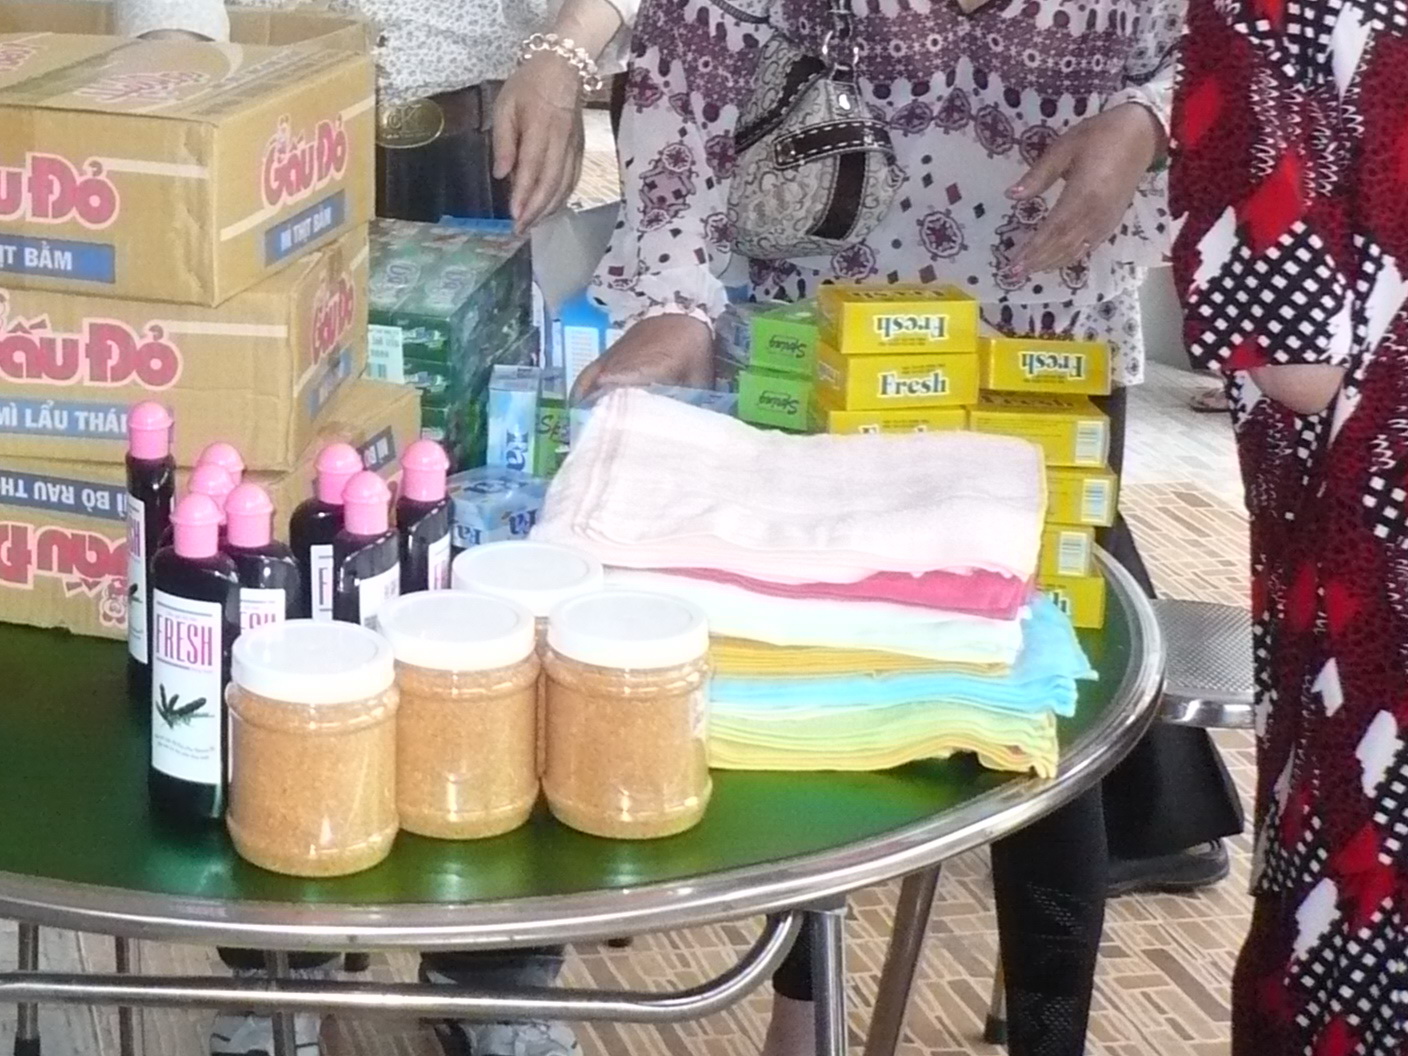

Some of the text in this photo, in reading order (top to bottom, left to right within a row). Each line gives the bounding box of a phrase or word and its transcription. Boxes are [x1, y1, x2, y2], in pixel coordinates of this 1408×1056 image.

[24, 241, 73, 271] BẰM
[877, 315, 946, 337] Fresh
[768, 334, 806, 358] Spring
[1021, 352, 1083, 377] Fresh
[880, 372, 947, 395] Fresh
[758, 390, 800, 415] Spring
[25, 401, 68, 429] LẨU
[74, 408, 128, 433] THÁI
[34, 482, 74, 505] RAU
[81, 487, 110, 511] BÒ
[155, 613, 213, 667] FRESH
